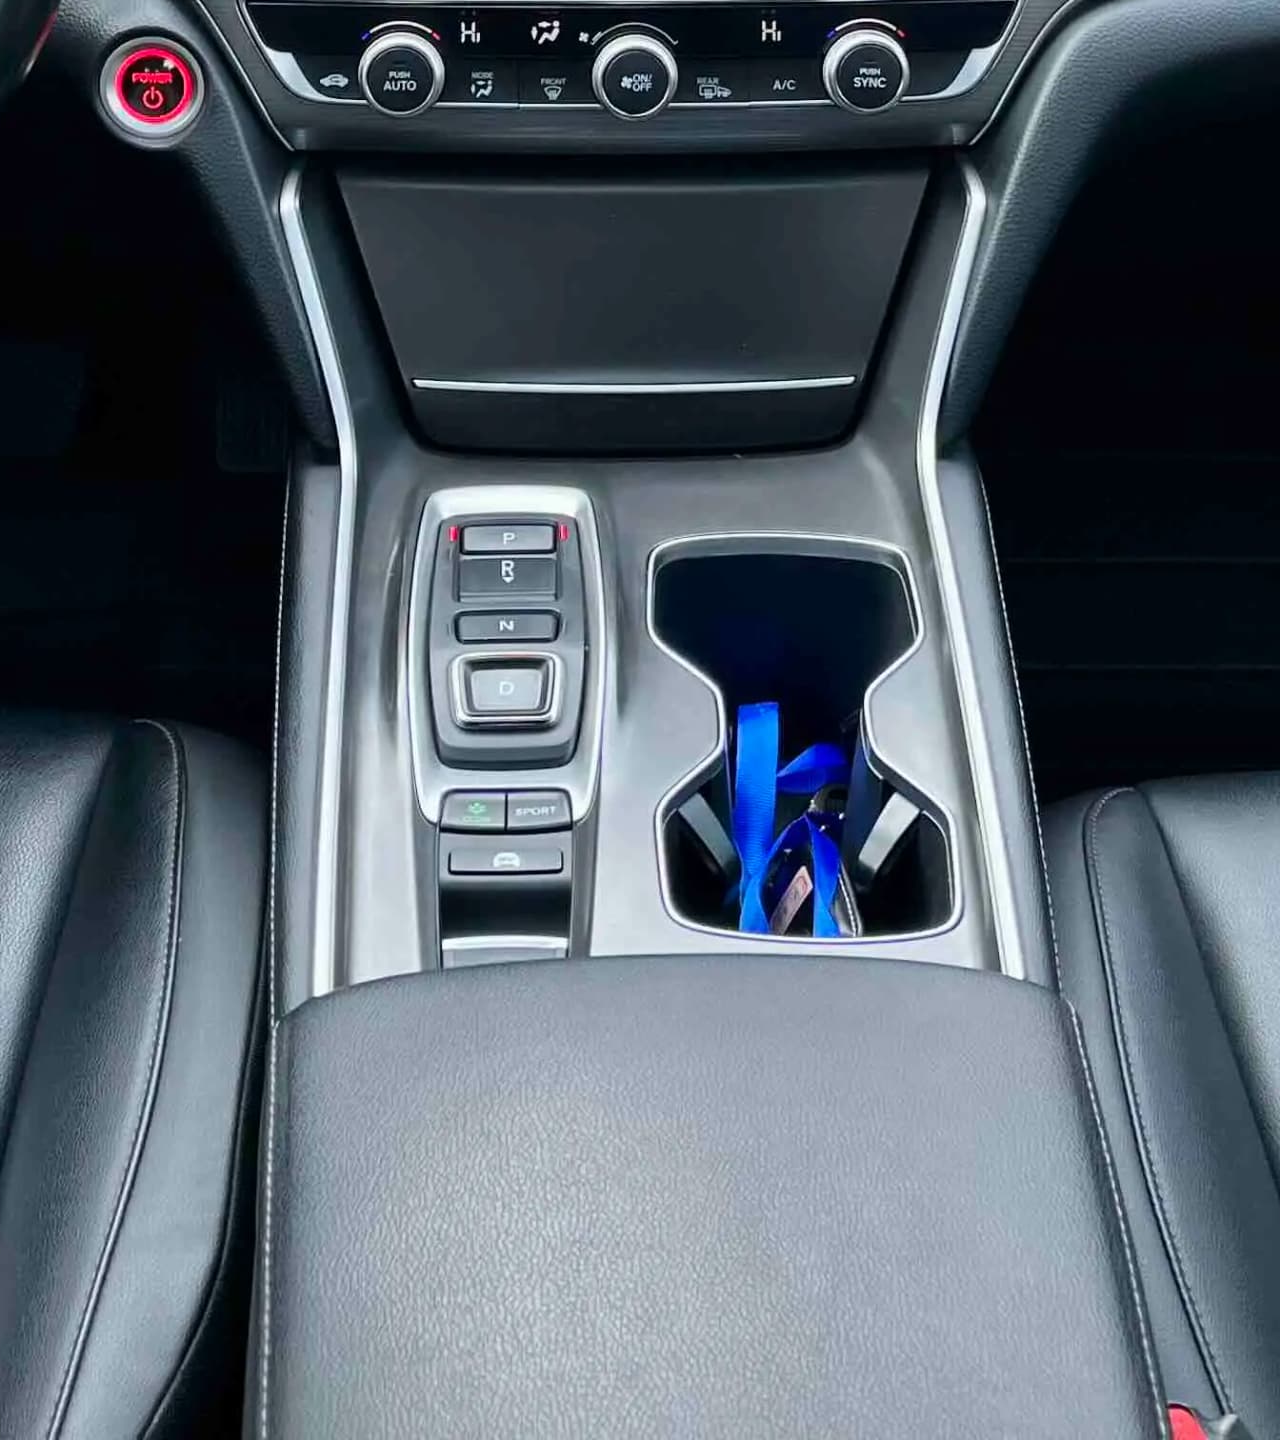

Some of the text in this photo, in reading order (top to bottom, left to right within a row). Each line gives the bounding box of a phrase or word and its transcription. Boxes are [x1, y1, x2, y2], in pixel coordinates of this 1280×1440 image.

[388, 71, 411, 79] PUSH
[860, 67, 881, 76] PUSH
[132, 72, 173, 84] POWER
[541, 78, 567, 86] FRONT
[853, 77, 887, 89] SYNC
[383, 80, 417, 92] AUTO
[633, 83, 653, 92] OFF
[773, 79, 797, 91] A/C
[503, 532, 516, 545] P
[501, 560, 515, 577] R
[499, 620, 515, 632] N
[499, 680, 515, 695] D
[515, 806, 557, 817] SPORT
